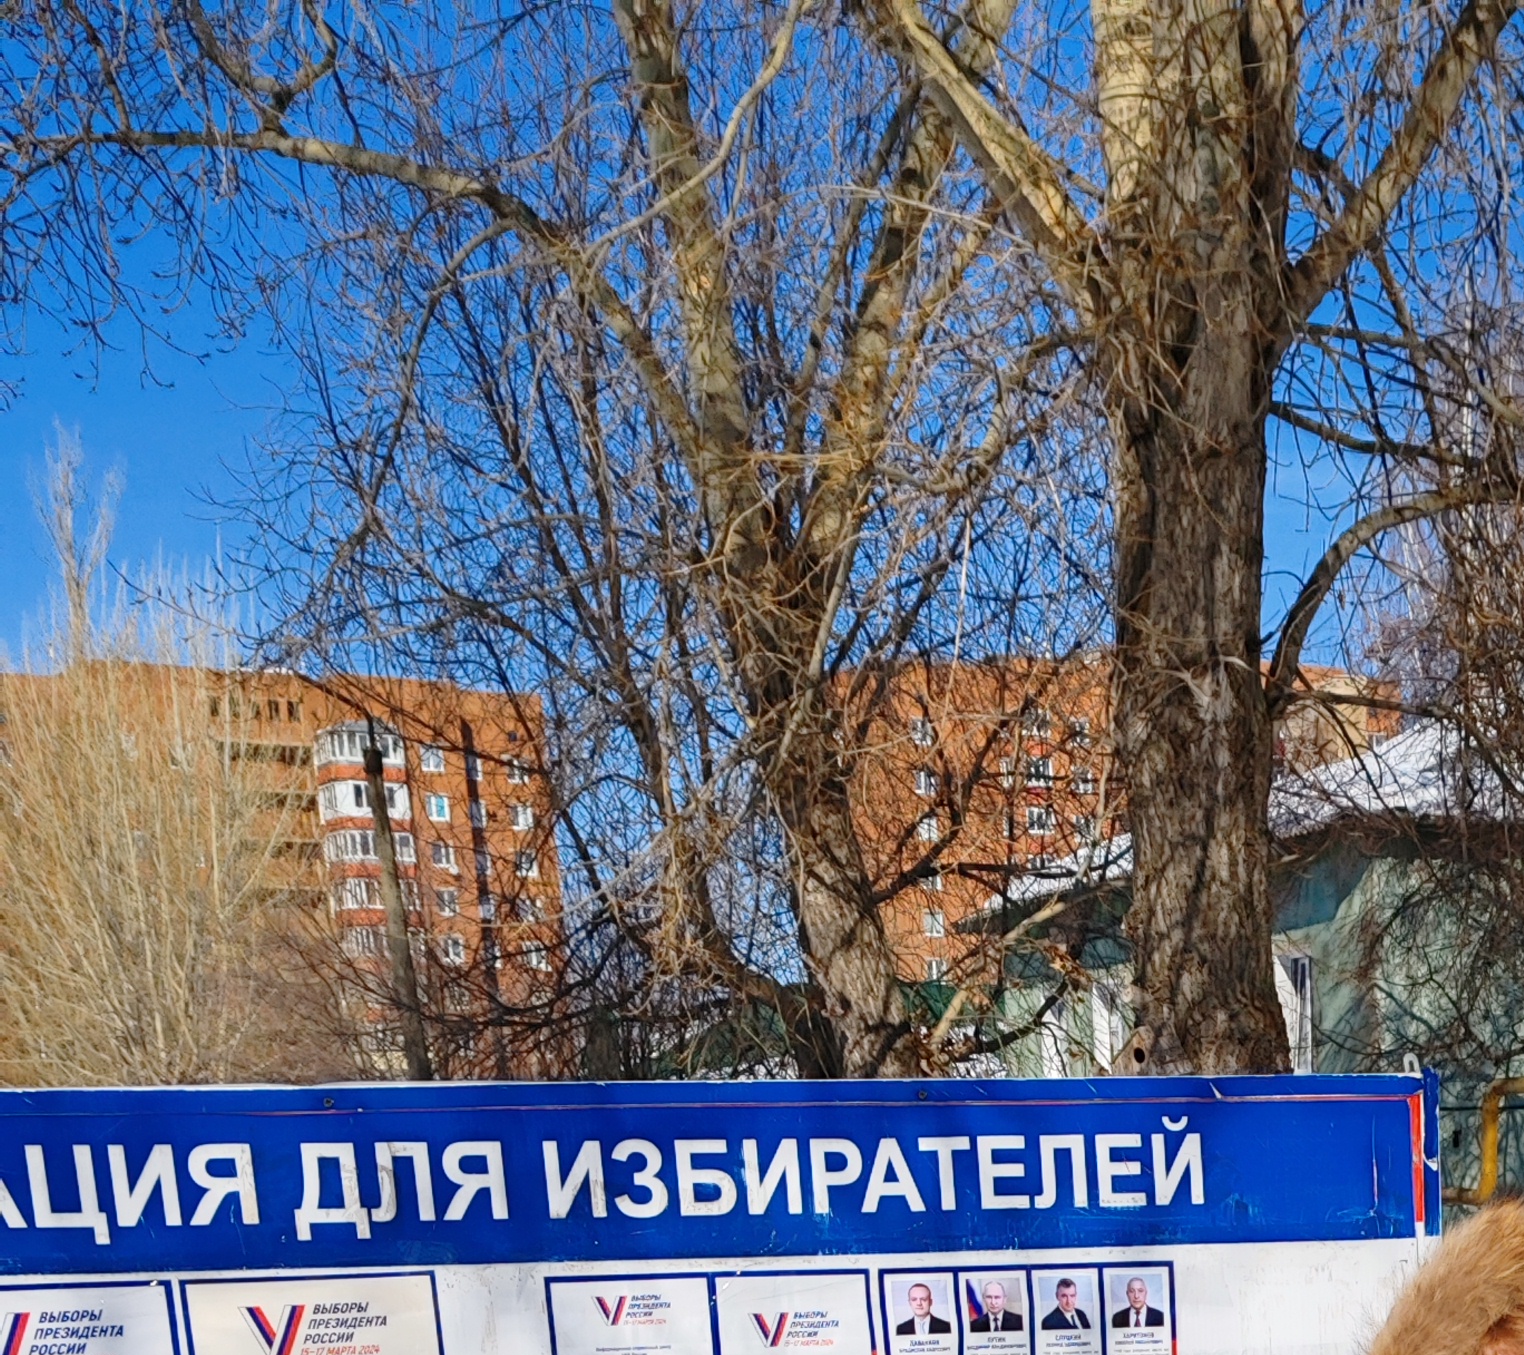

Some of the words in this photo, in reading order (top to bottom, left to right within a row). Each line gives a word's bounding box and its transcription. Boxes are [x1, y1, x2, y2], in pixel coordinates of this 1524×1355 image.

[294, 1140, 509, 1241] ДЛЯ
[542, 1115, 1205, 1219] ИЗБИРАТЕЛЕЙ
[312, 1302, 369, 1315] ВЫБОРЫ
[38, 1309, 103, 1323] ВЫБОРЫ
[307, 1316, 388, 1330] ПРЕЗИДЕНТА
[790, 1320, 839, 1328] ПРЕЗИДЕНТА
[34, 1325, 124, 1340] ПРЕЗИДЕНТА
[303, 1331, 354, 1345] РОССИИ
[787, 1330, 819, 1338] РОССИИ
[29, 1343, 87, 1355] РОССИИ
[326, 1346, 356, 1355] МАРТА
[358, 1344, 380, 1355] 2024
